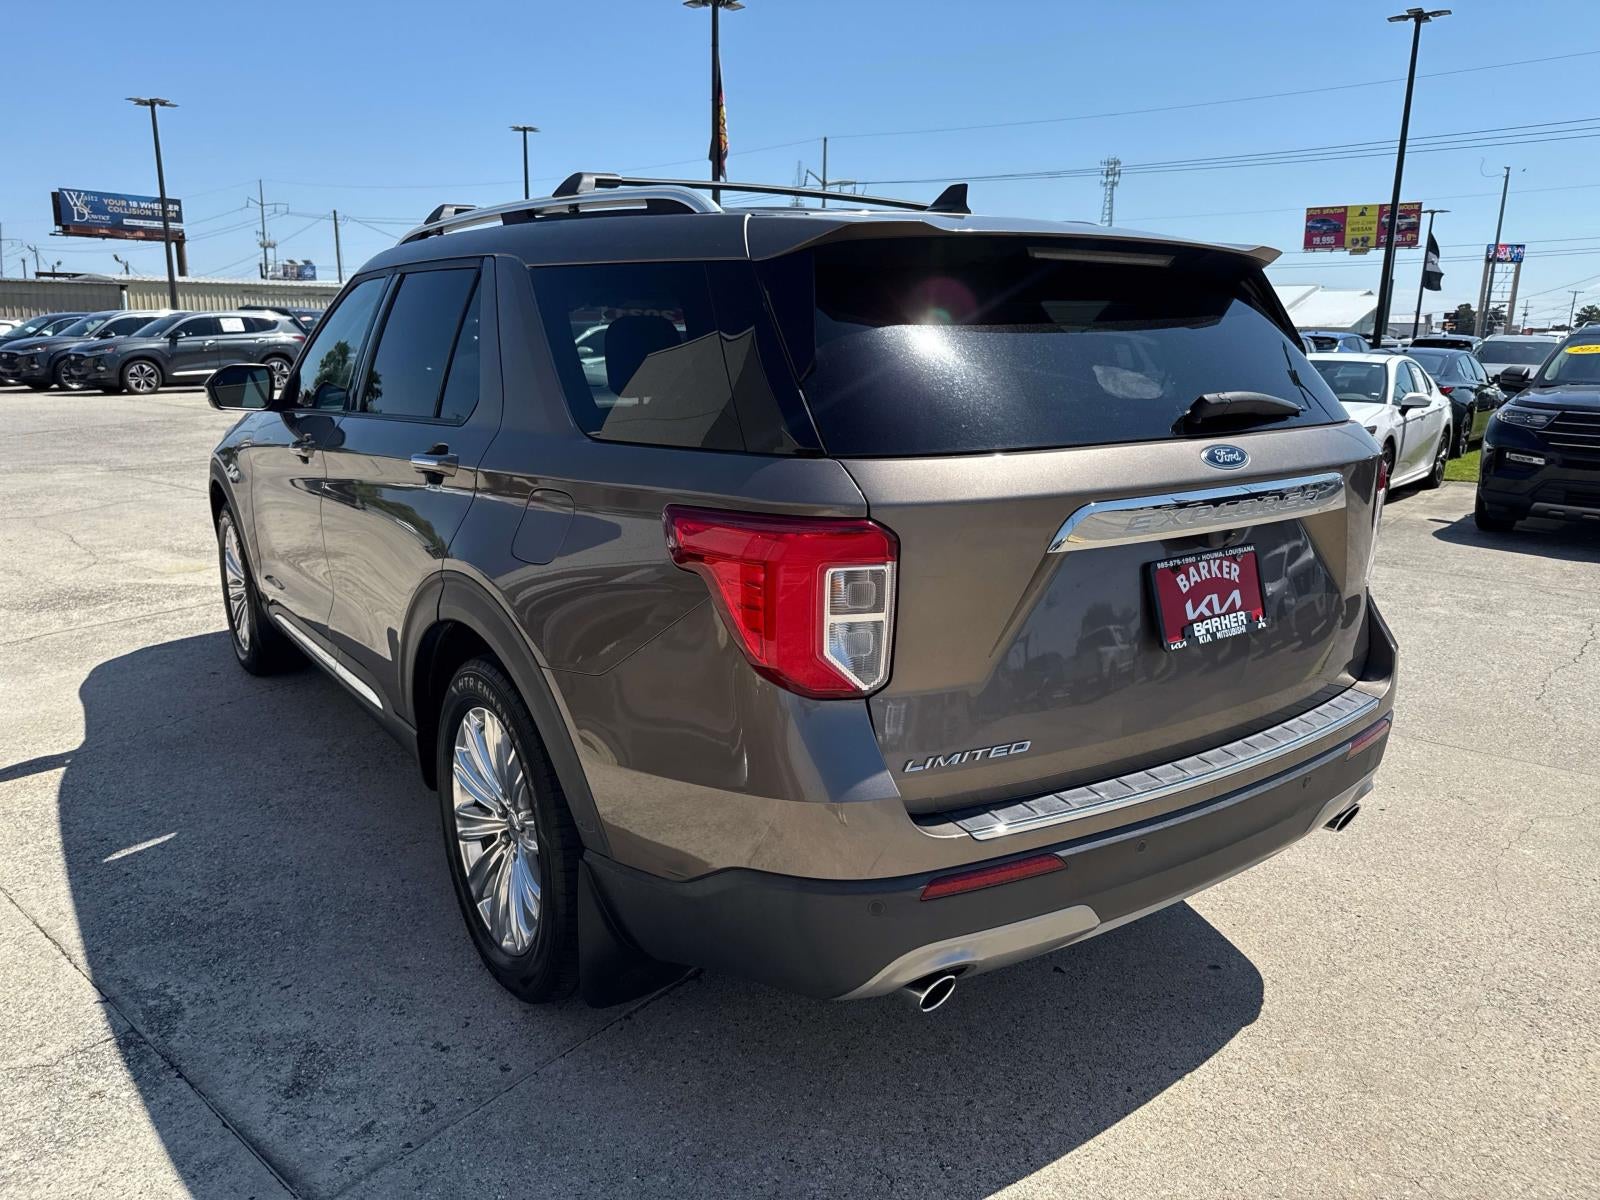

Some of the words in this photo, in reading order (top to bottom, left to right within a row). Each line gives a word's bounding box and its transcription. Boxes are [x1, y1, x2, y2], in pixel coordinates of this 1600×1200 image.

[103, 198, 127, 207] YOUR
[129, 200, 138, 208] 18
[107, 205, 152, 217] COLLISION
[153, 209, 176, 218] TEM
[1214, 448, 1242, 463] Ford
[1126, 488, 1320, 531] EXPLORER
[1225, 545, 1255, 557] LOUISIANA
[1175, 559, 1240, 594] BARKER
[1185, 589, 1242, 620] KIA
[1193, 611, 1247, 637] BARKER
[1198, 635, 1213, 645] KIA
[1216, 625, 1247, 640] MITSUBISHI
[903, 740, 1032, 773] LIMITED
